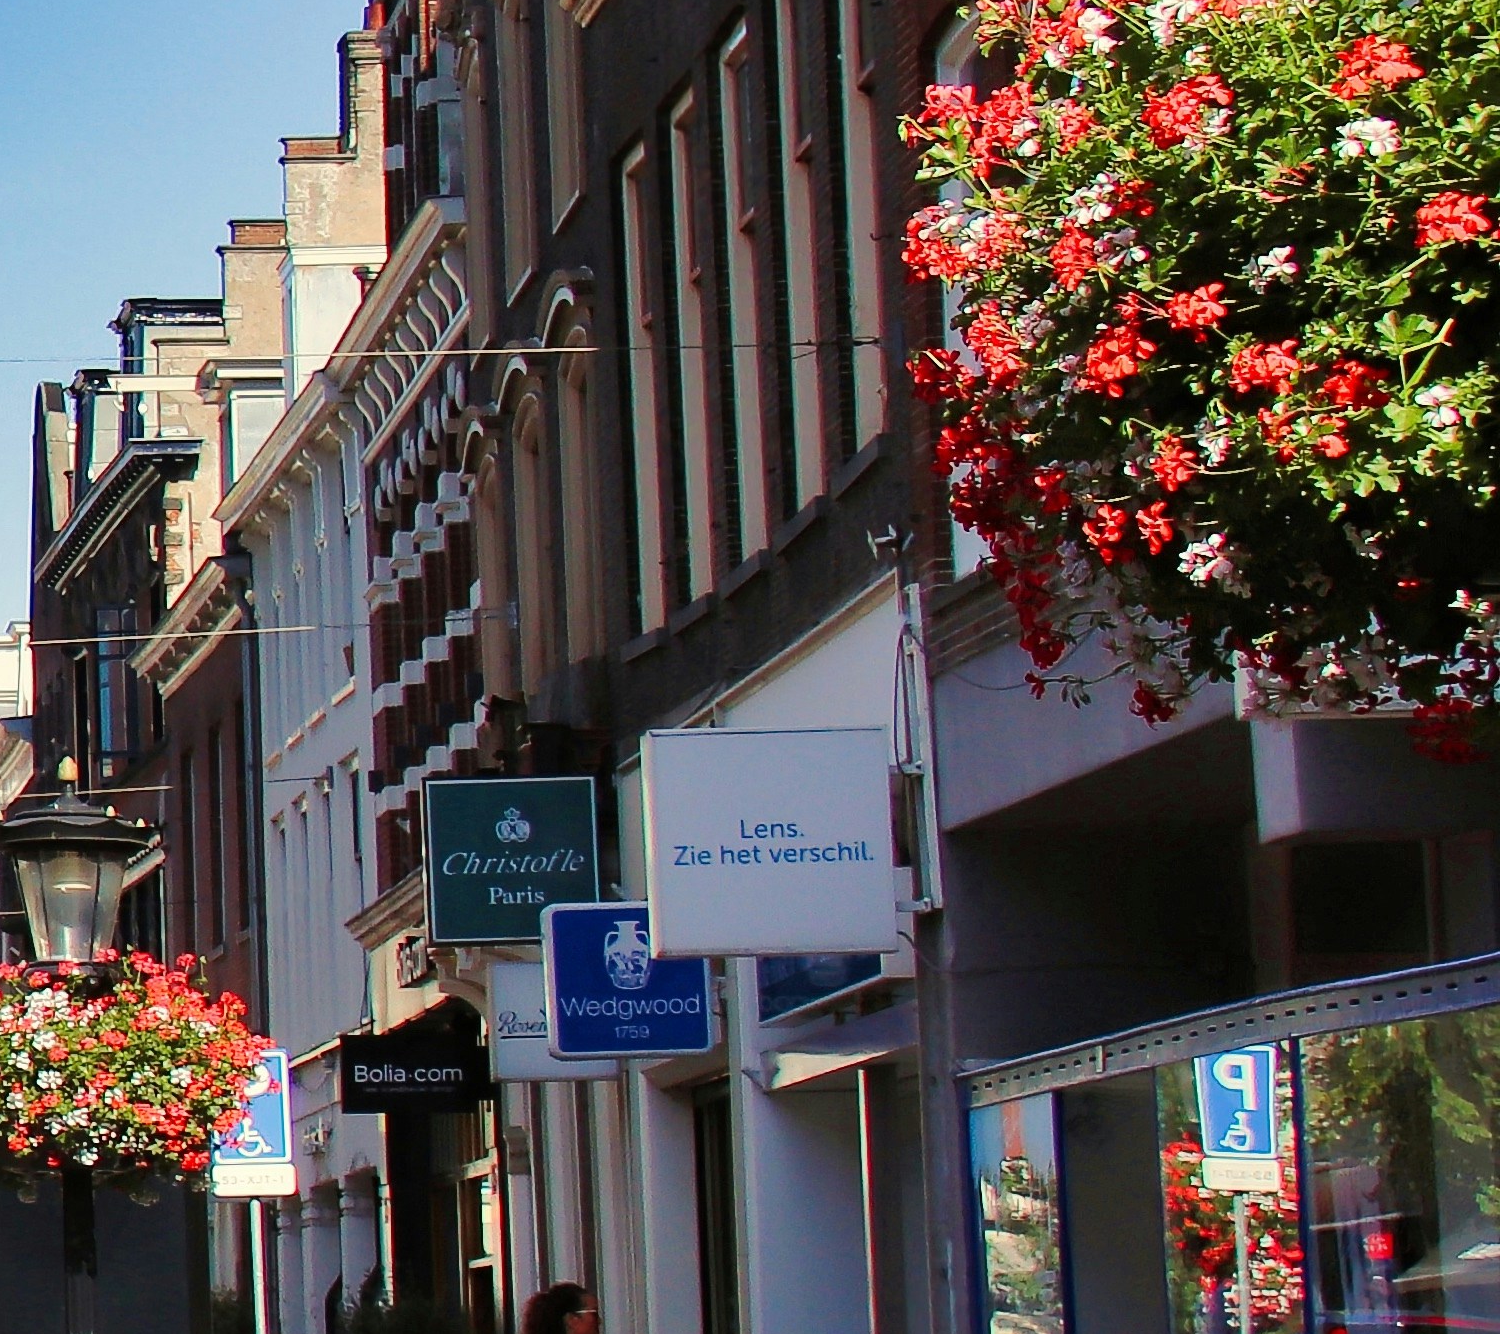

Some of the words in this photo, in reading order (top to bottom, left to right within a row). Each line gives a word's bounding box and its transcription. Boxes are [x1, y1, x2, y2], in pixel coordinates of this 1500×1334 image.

[740, 819, 805, 839] Lens.
[442, 848, 585, 875] Christofle
[673, 845, 712, 866] Zie
[719, 845, 762, 865] het
[768, 841, 874, 864] verschil.
[488, 885, 545, 905] Paris
[560, 993, 700, 1020] Wedgwood
[615, 1025, 650, 1039] 1759
[222, 1175, 284, 1185] 53-XJT-1
